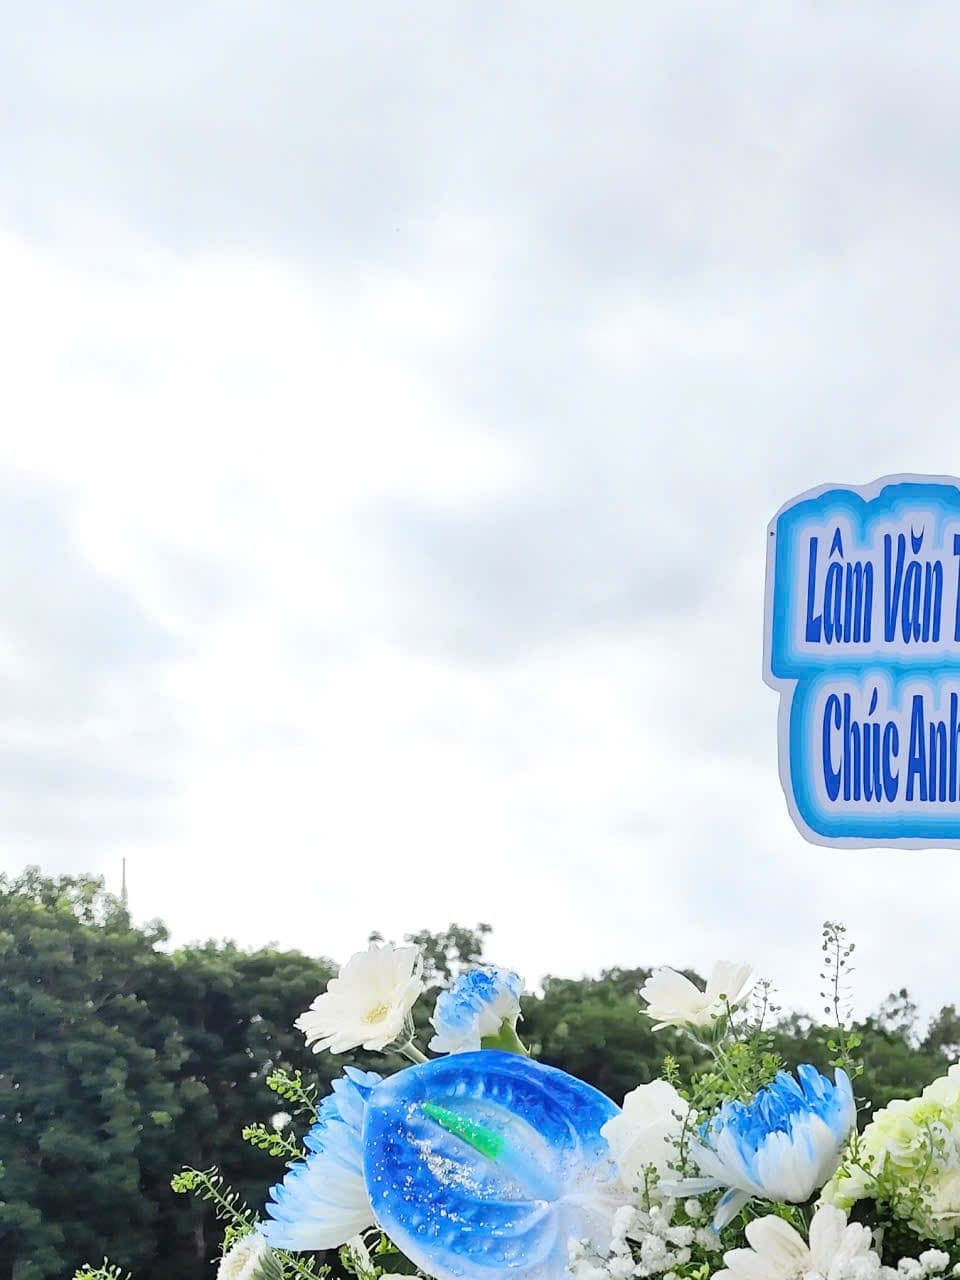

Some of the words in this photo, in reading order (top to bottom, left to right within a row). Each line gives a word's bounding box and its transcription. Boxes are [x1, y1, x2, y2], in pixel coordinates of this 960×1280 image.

[805, 527, 874, 645] Lâm
[884, 526, 943, 644] Văn
[822, 687, 899, 803] Chúc
